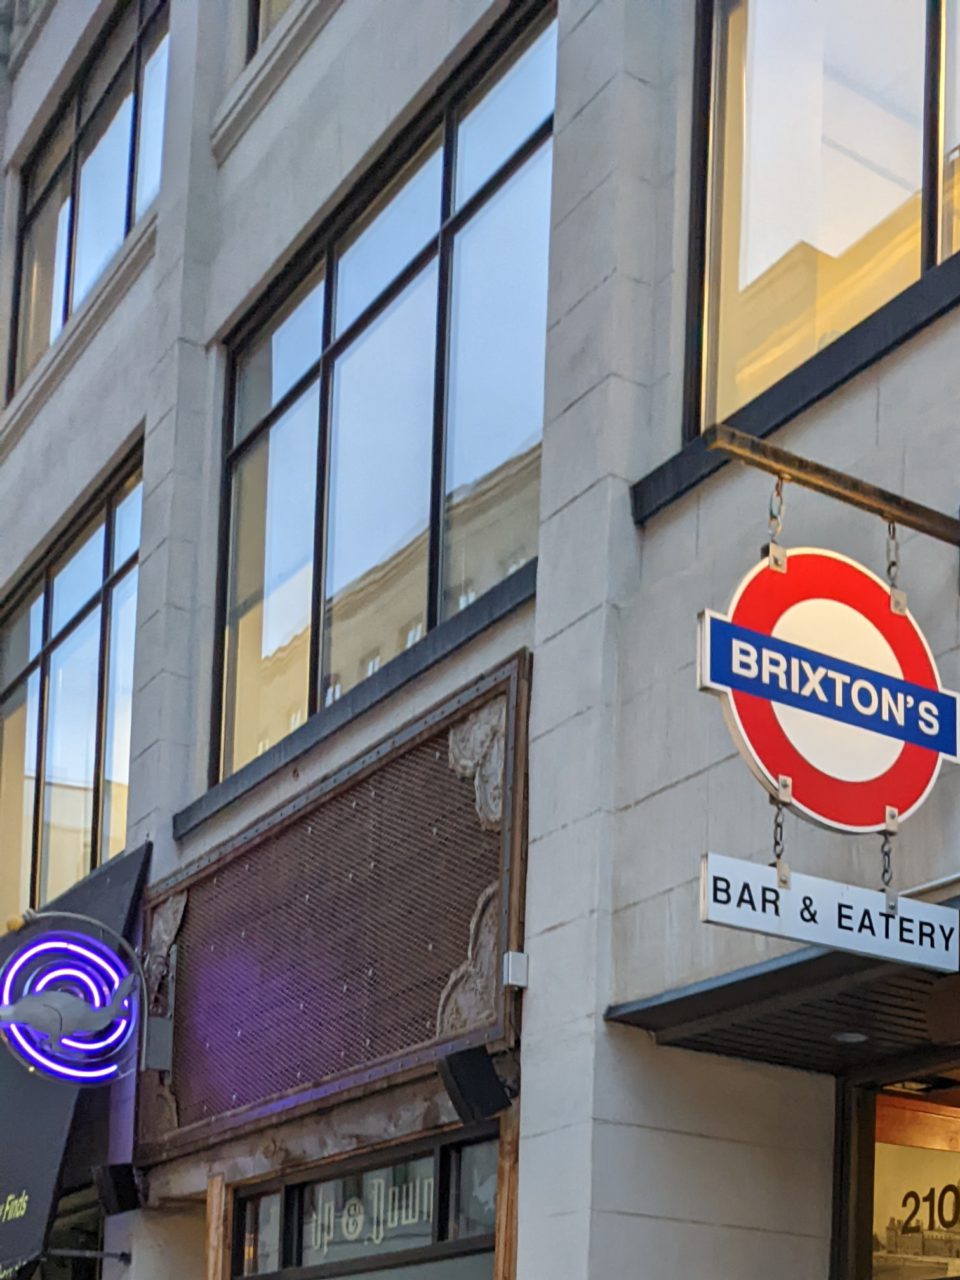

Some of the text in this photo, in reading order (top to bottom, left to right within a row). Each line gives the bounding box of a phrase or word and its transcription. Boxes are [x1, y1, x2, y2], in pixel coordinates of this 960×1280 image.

[731, 637, 940, 736] BRIXTON'S
[712, 875, 955, 952] BAR & EATERY
[342, 1196, 364, 1240] &
[901, 1183, 960, 1235] 210
